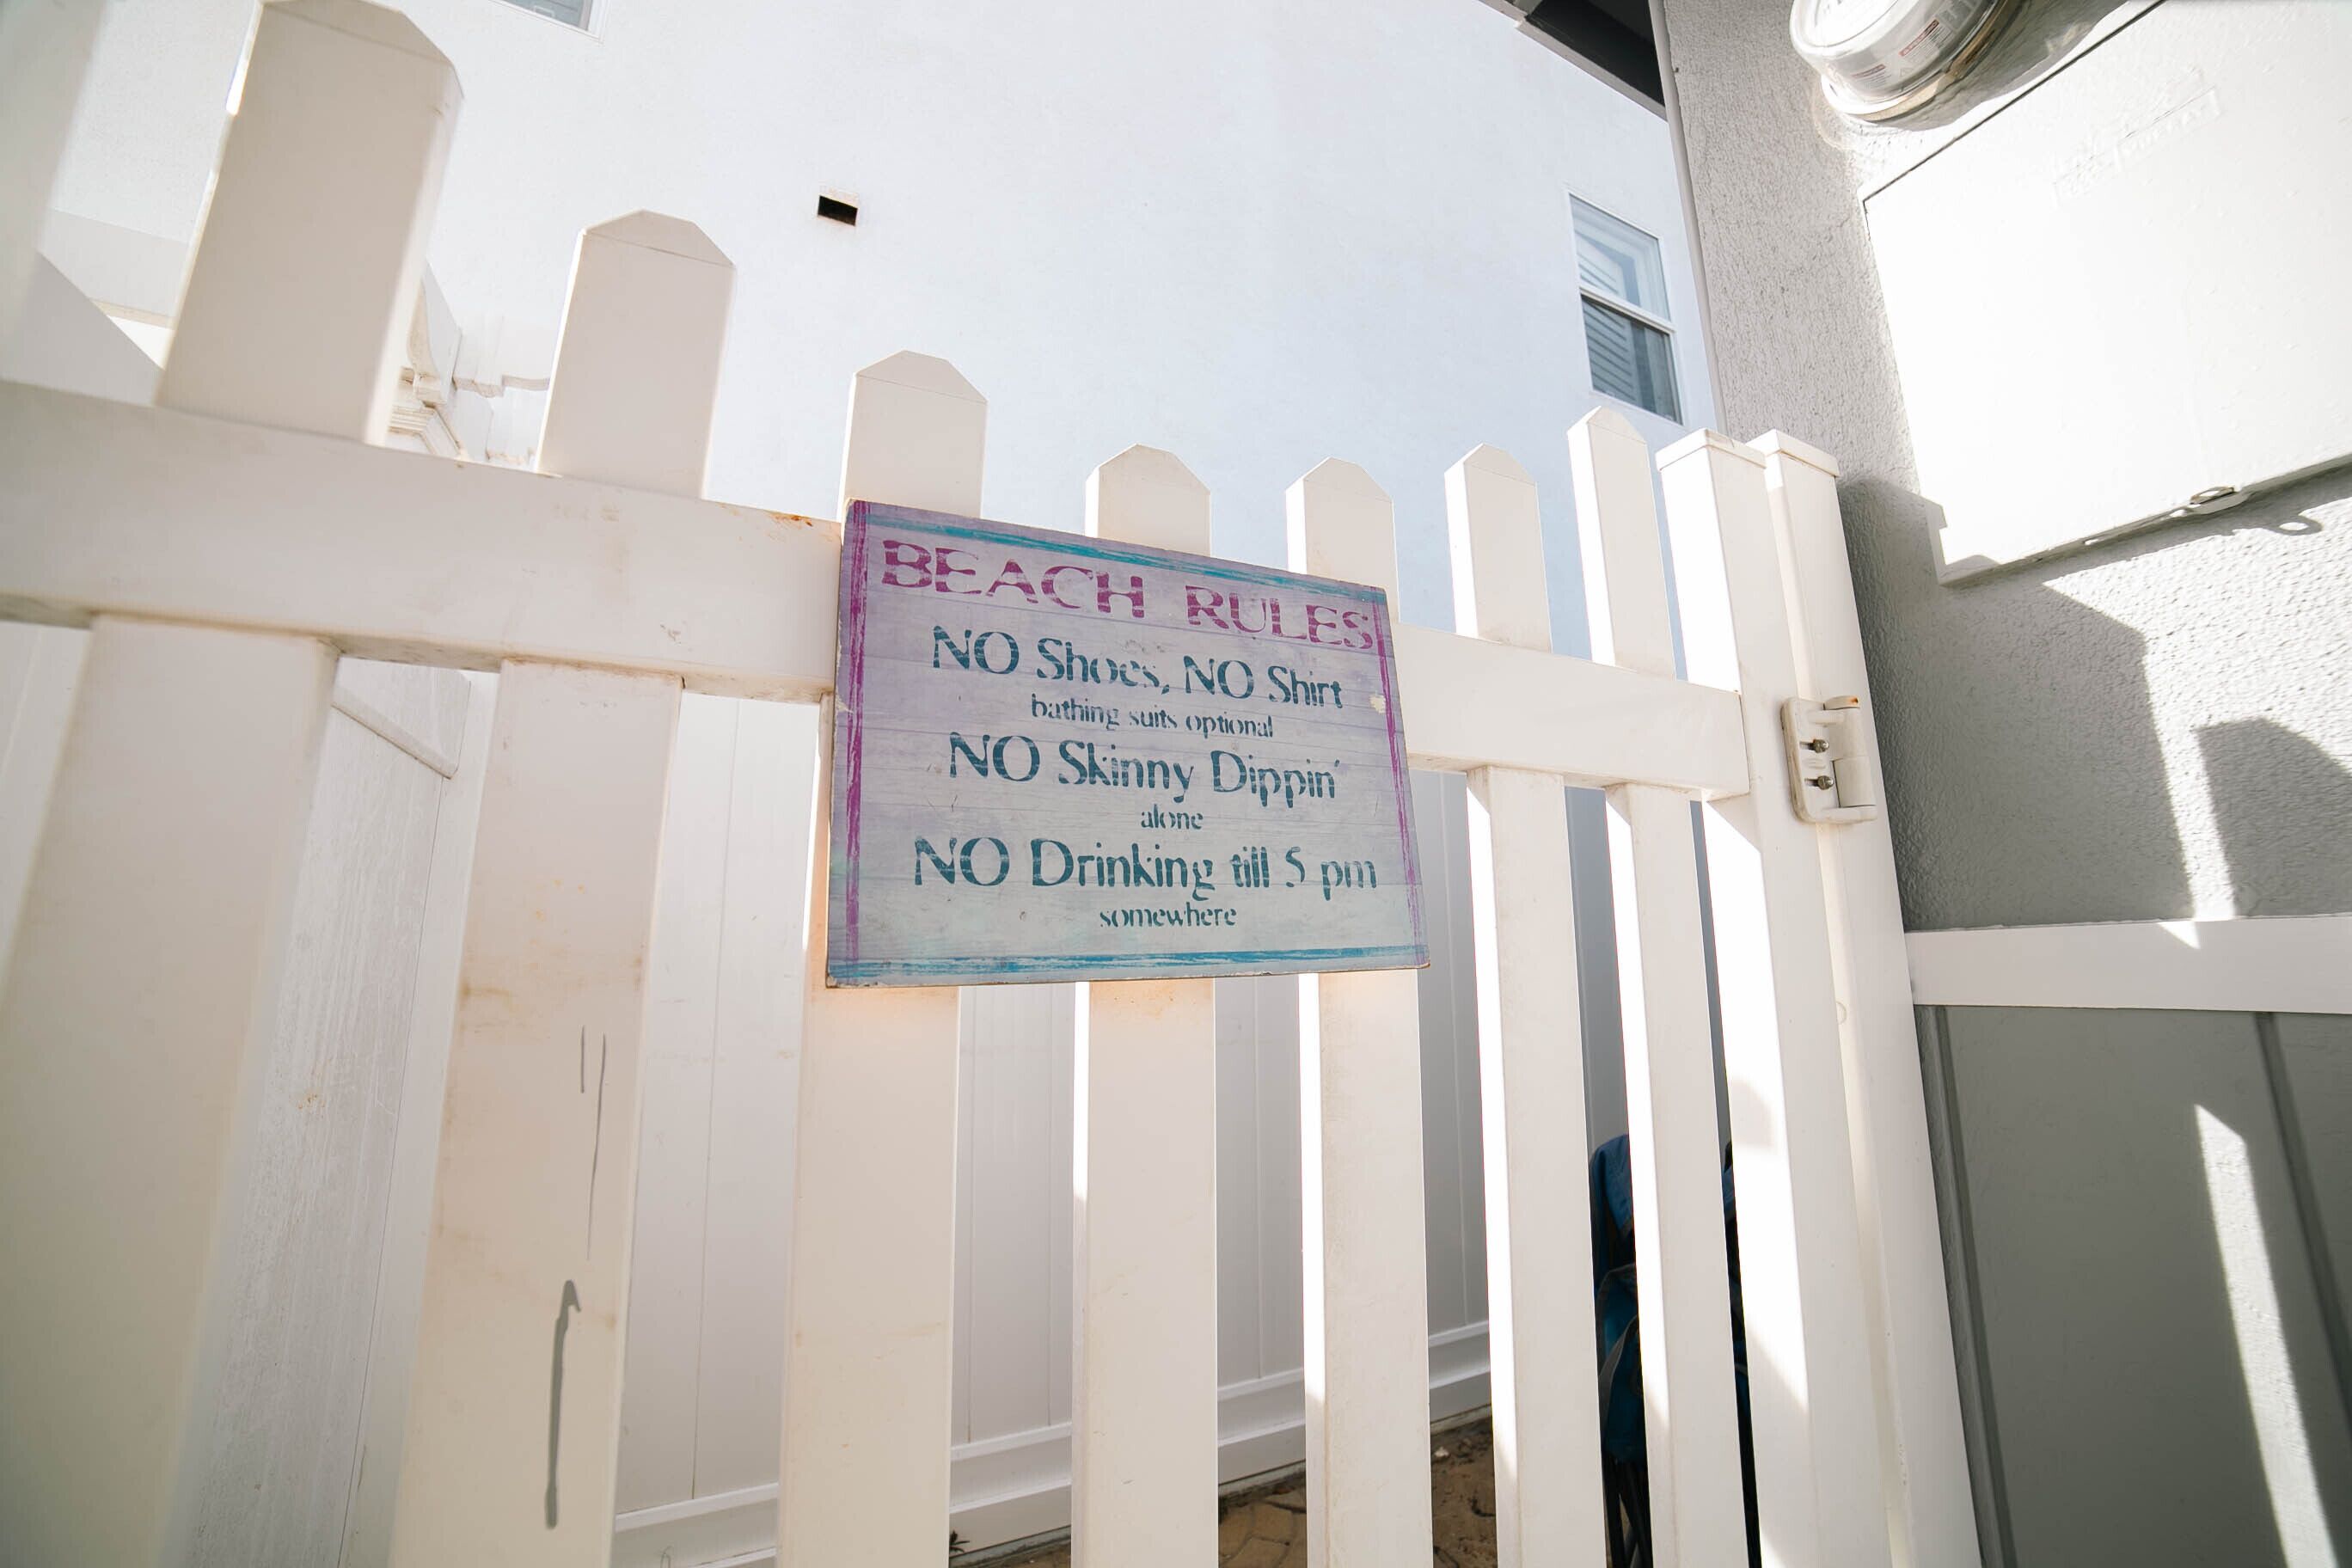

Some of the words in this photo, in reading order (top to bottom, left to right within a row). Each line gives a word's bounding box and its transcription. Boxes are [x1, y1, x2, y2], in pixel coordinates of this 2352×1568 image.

[882, 539, 1146, 618] BEACH
[1185, 584, 1375, 651] RULES
[932, 626, 1020, 675] NO
[1036, 637, 1172, 695] Shoes,
[1183, 654, 1255, 700] NO
[1267, 665, 1344, 709] Shirt
[1032, 693, 1120, 731] bathing
[1129, 705, 1178, 732] suits
[1185, 712, 1274, 739] optional
[949, 732, 1040, 781] NO
[1058, 739, 1194, 804] Skinny
[1140, 805, 1204, 830] alone
[914, 837, 1009, 887] NO
[1031, 837, 1214, 901] Drinking
[1231, 845, 1271, 889] till
[1286, 846, 1307, 888] 5
[1321, 854, 1377, 901] pm
[1099, 900, 1238, 928] somewhere
